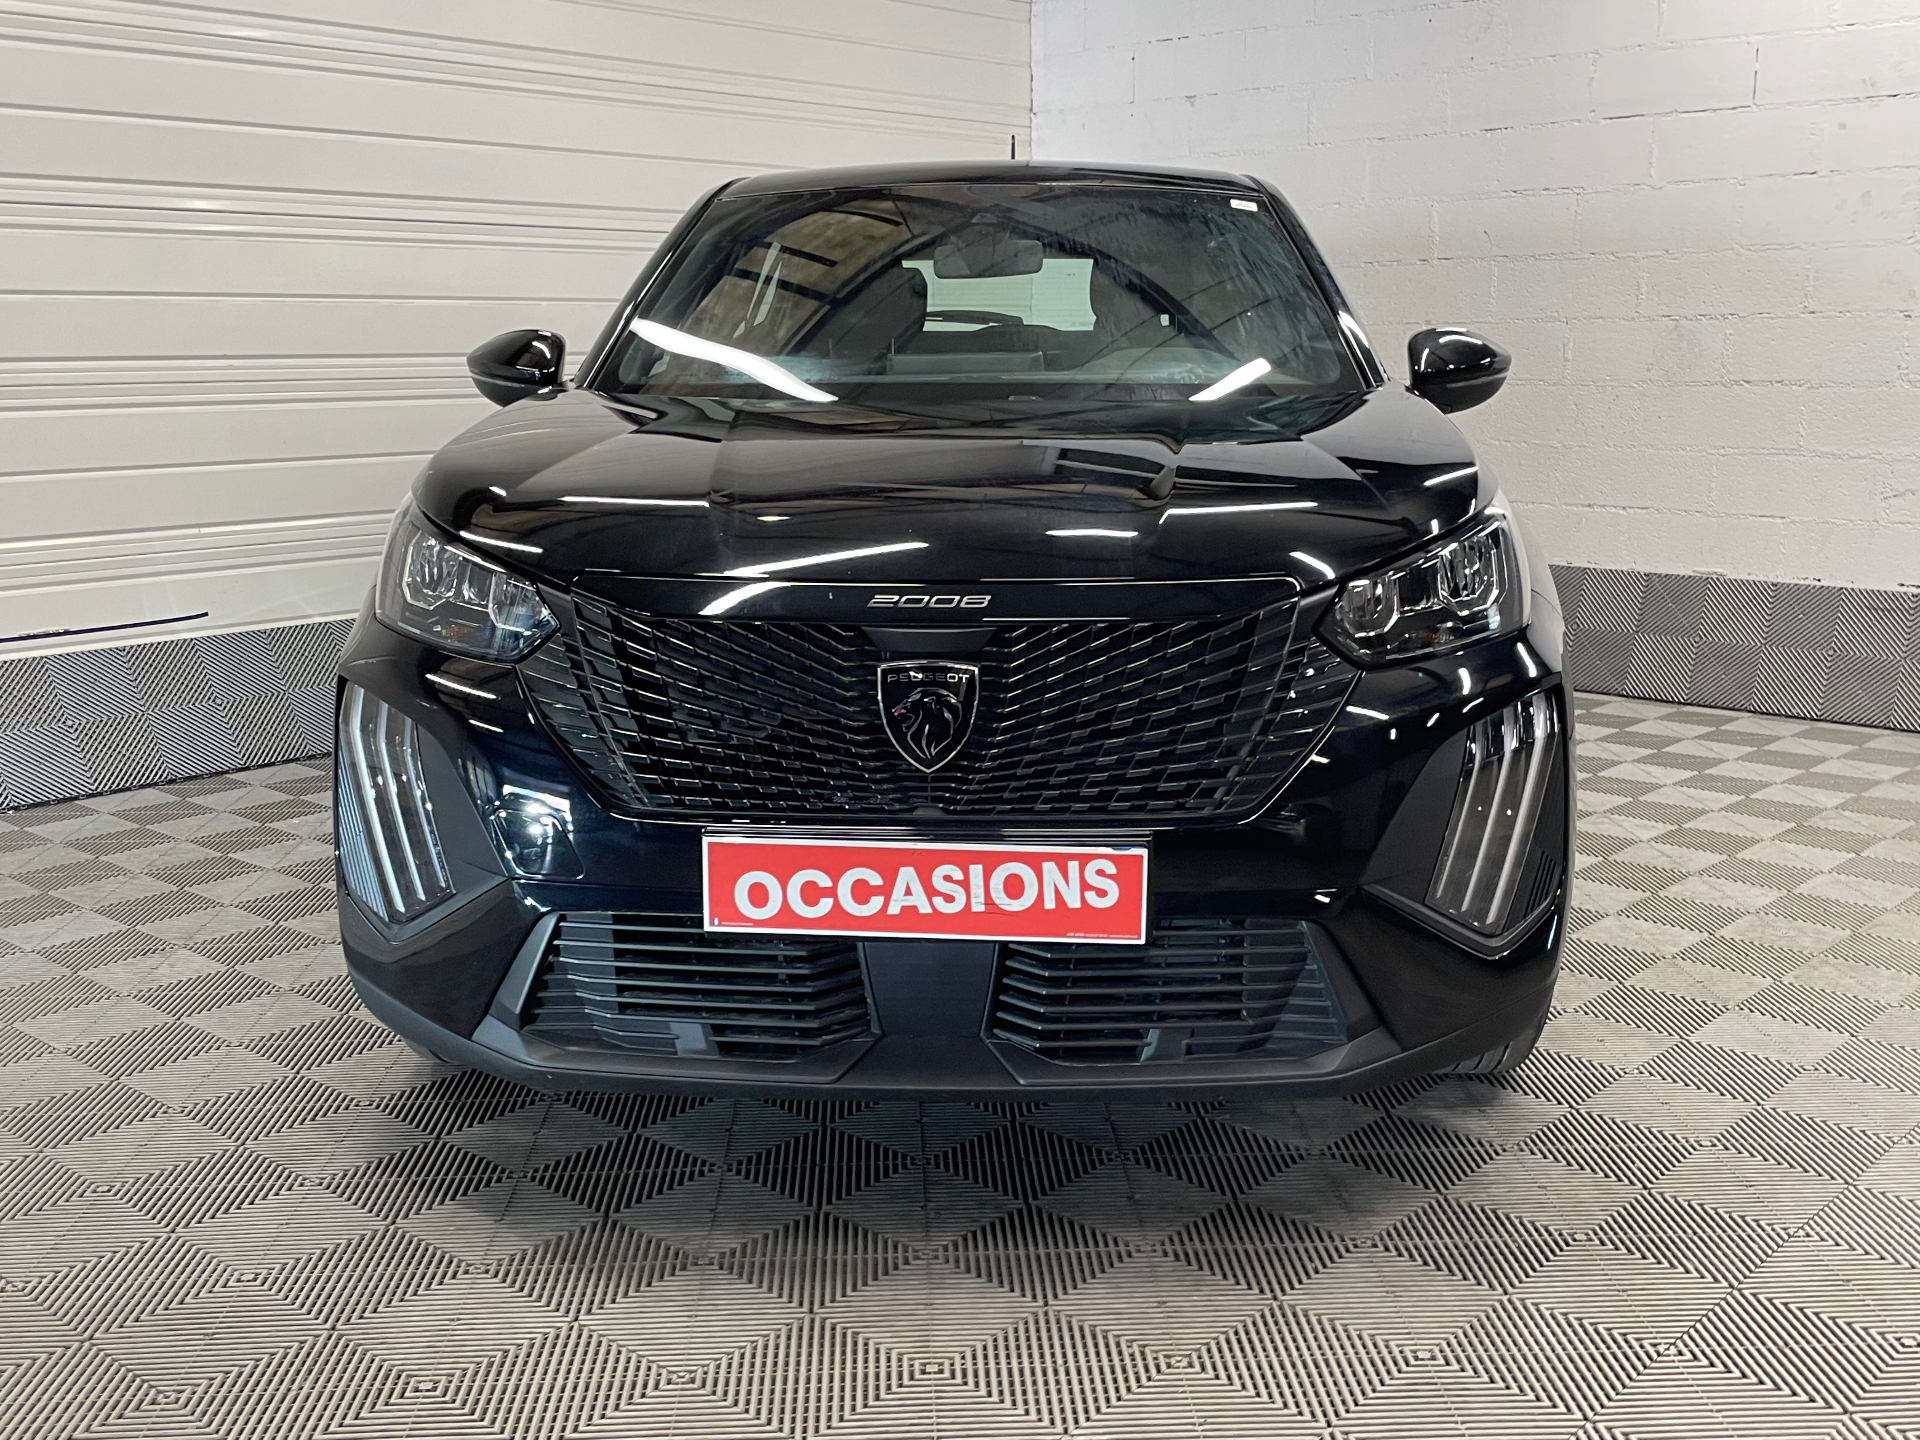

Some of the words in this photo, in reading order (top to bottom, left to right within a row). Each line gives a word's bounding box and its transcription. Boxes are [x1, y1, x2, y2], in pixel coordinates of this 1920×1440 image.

[867, 595, 992, 608] 2008
[887, 673, 970, 684] PEUGEOT
[734, 859, 1120, 920] OCCASIONS
